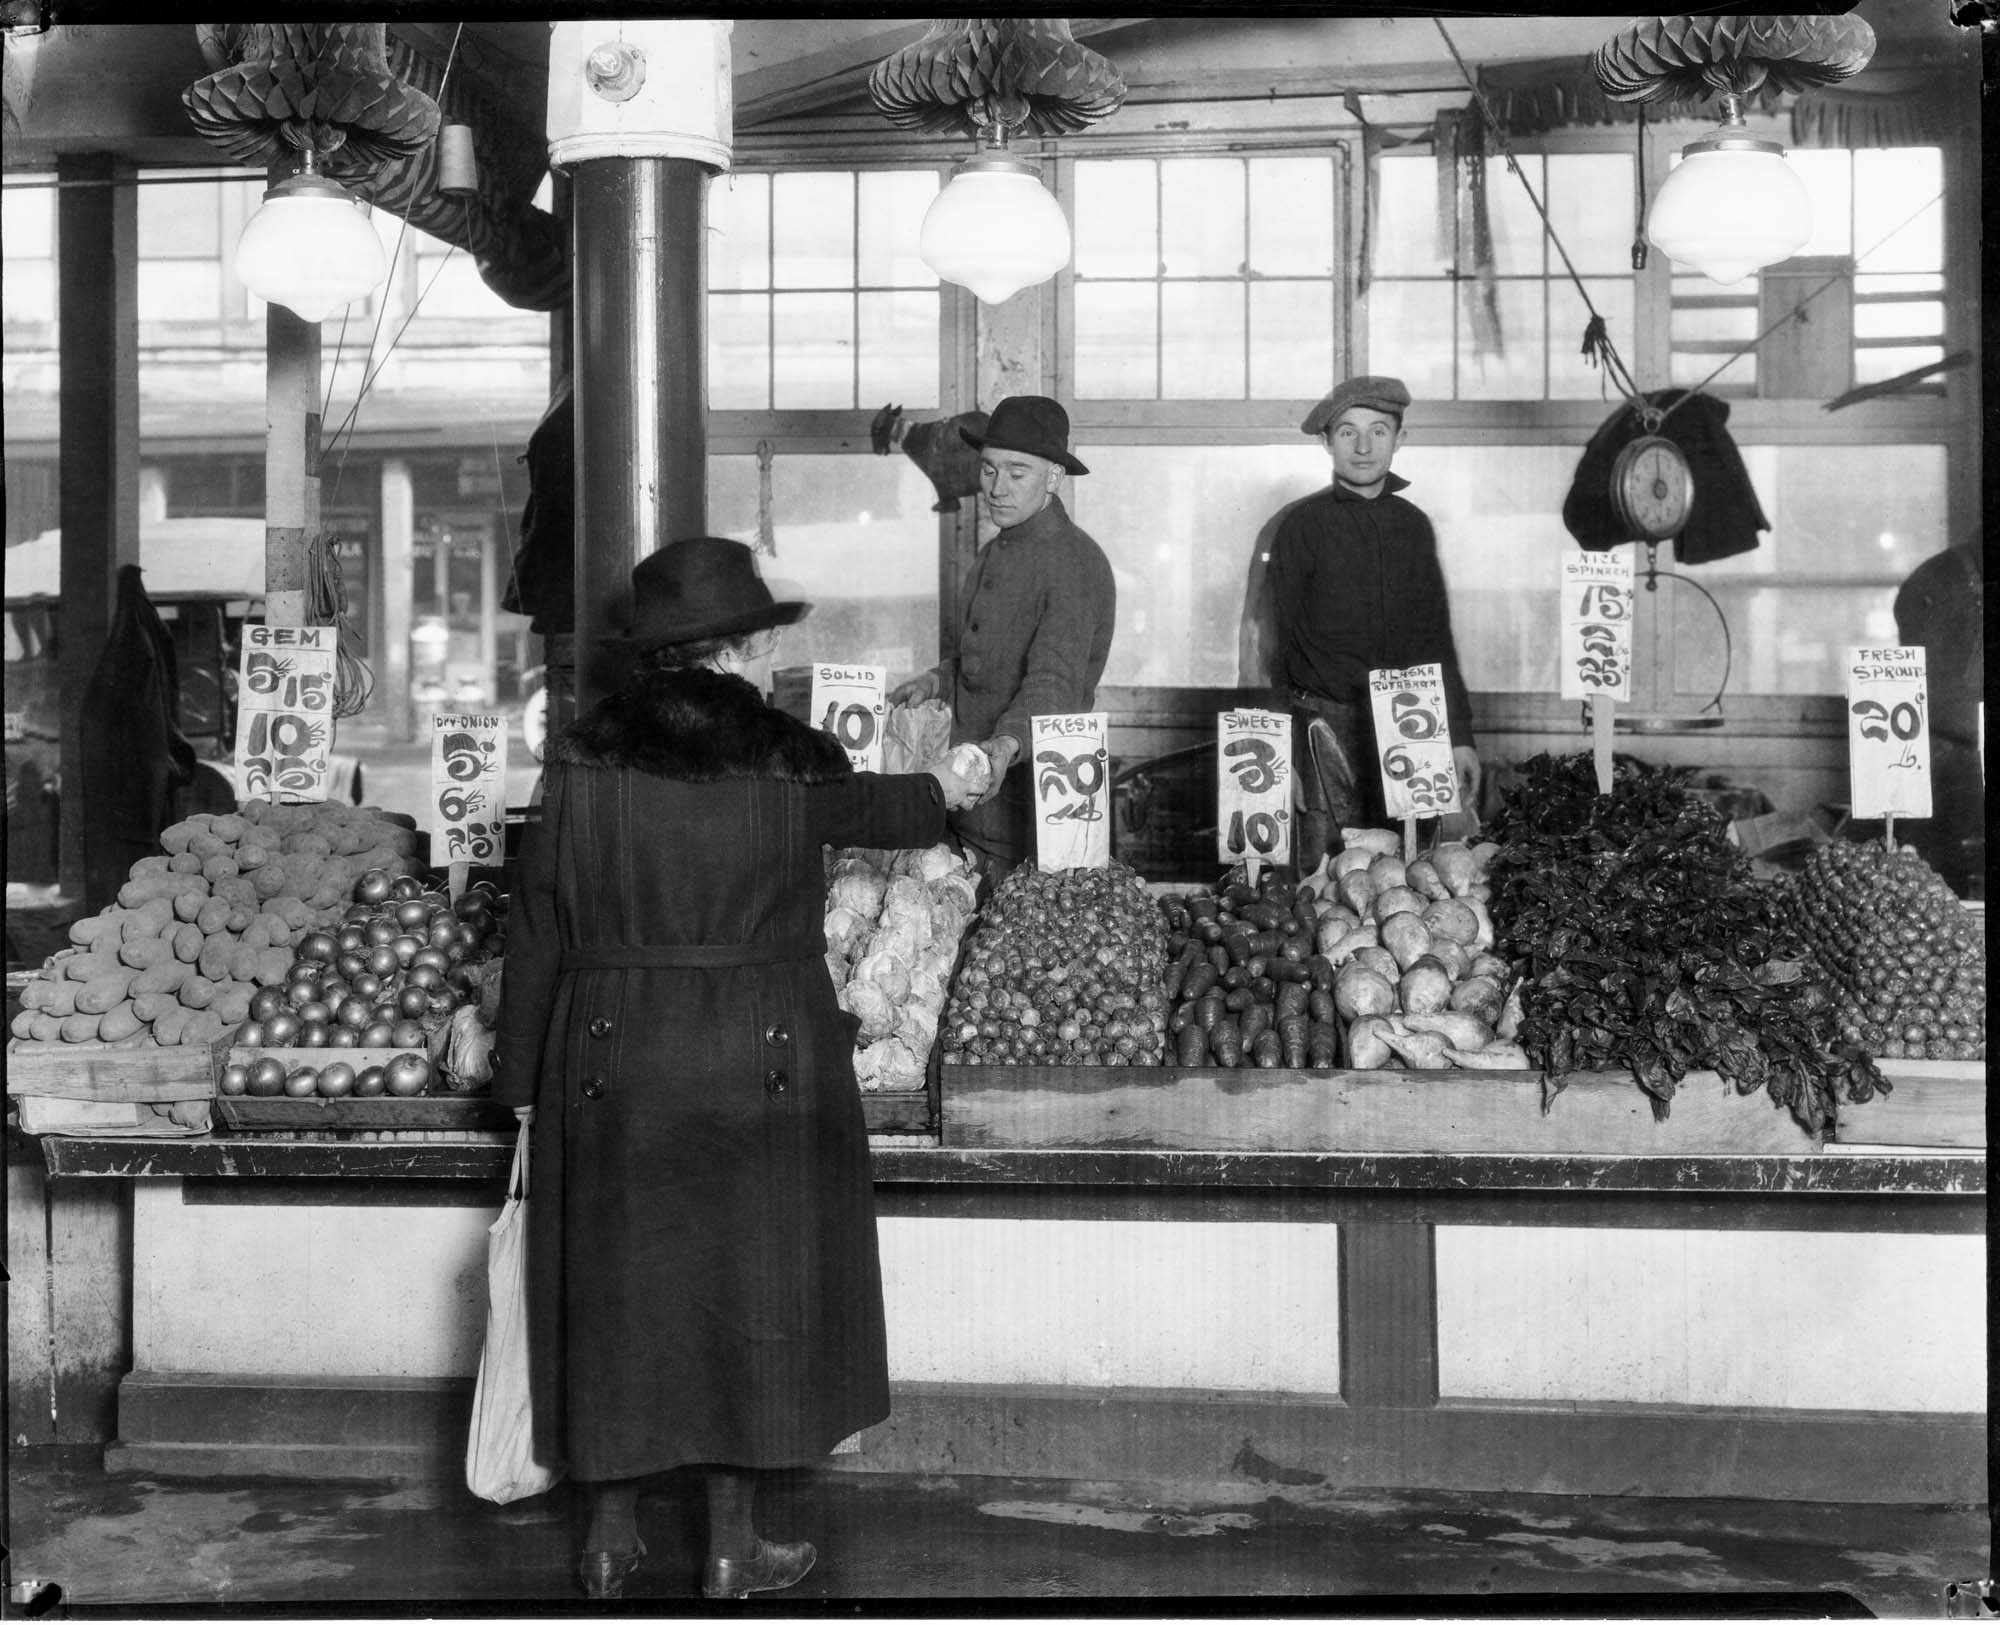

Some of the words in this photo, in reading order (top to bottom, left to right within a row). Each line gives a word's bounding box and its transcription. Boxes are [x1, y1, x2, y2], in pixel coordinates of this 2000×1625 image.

[250, 626, 320, 648] GEM
[1580, 625, 1617, 658] 2
[1859, 649, 1916, 661] FRESH
[247, 652, 280, 695] 5
[819, 667, 876, 681] SOLID
[1379, 666, 1435, 681] ALASKA
[247, 712, 312, 757] 10
[1037, 717, 1099, 736] FRESH
[1224, 713, 1285, 729] SWEET
[1224, 737, 1277, 794] 3
[1383, 744, 1416, 781] 6
[439, 787, 468, 823] 6
